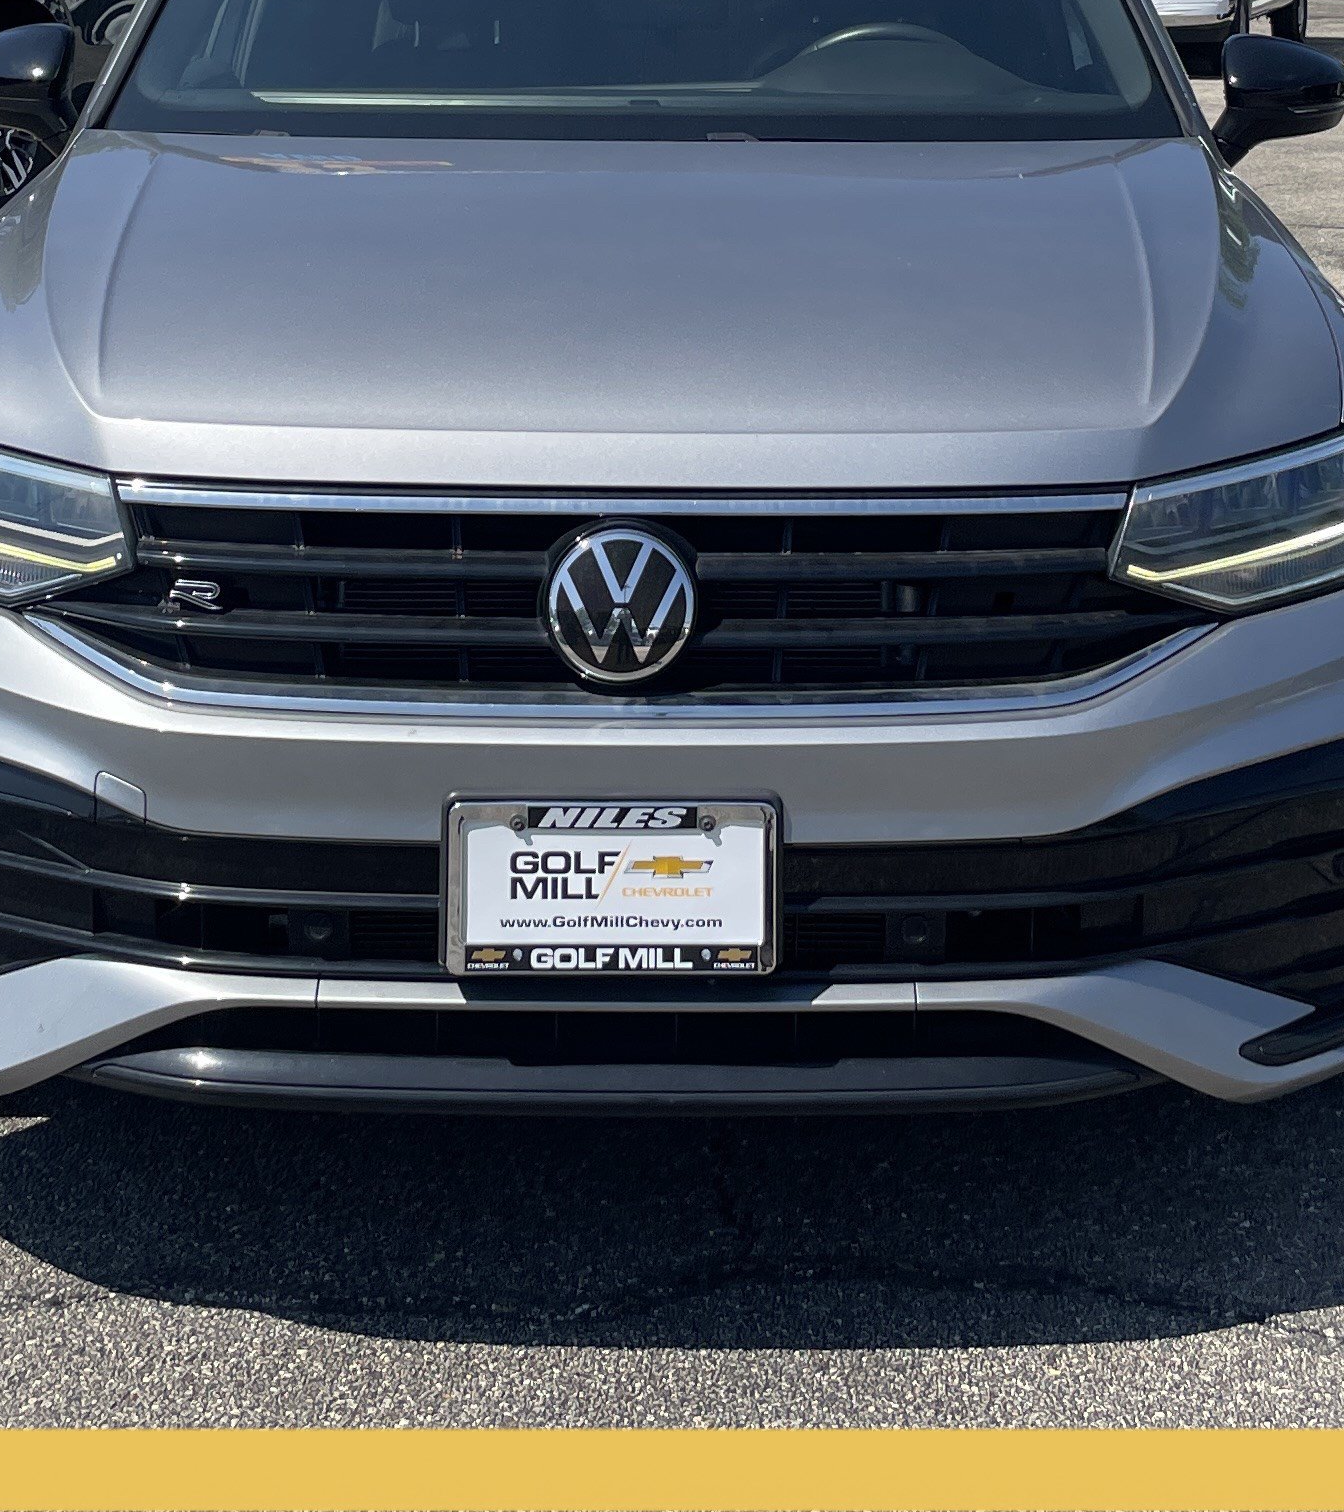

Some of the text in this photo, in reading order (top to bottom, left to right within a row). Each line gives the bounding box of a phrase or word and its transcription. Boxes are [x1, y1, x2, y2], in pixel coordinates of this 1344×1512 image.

[538, 807, 687, 829] NILES
[509, 850, 621, 875] GOLF
[509, 876, 599, 901] MILL
[621, 886, 714, 898] CHEVROLET
[500, 914, 723, 931] www.GolfMillChevy.com
[529, 947, 693, 970] GOLF MILL
